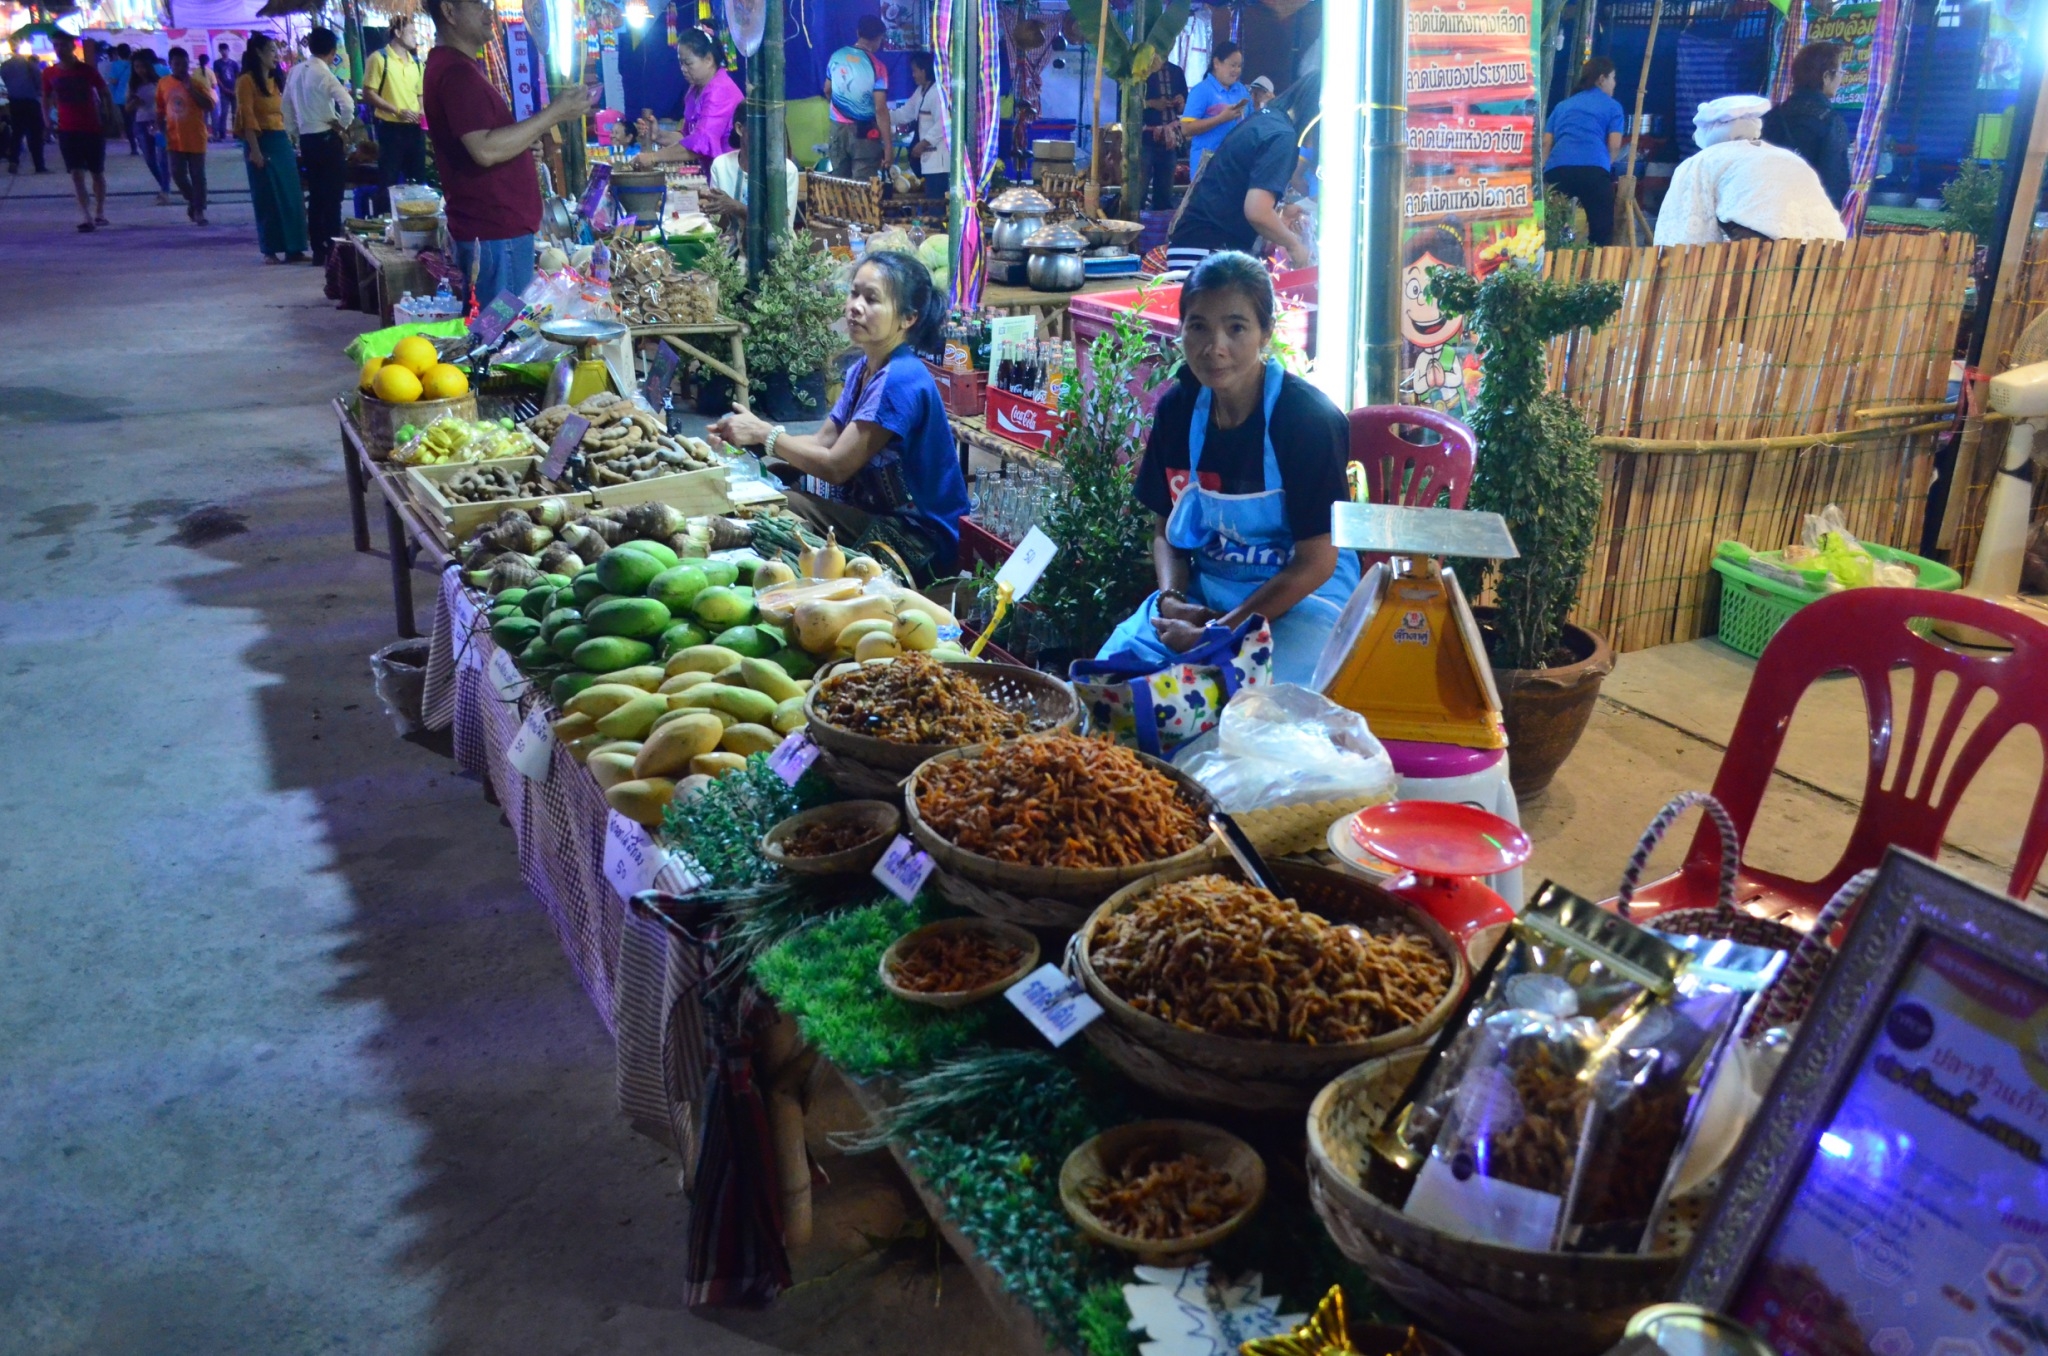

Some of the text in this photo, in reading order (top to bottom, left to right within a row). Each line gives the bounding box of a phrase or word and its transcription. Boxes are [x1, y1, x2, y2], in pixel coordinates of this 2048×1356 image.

[1408, 2, 1526, 33] ลาดนัดแห่งทางเลือก
[1406, 62, 1526, 90] ลาดนัดของประชาชน
[1405, 120, 1523, 152] ลาดนัดแห่งอาชีพ
[1405, 179, 1527, 213] ลาดนัดแห่งโอกาส
